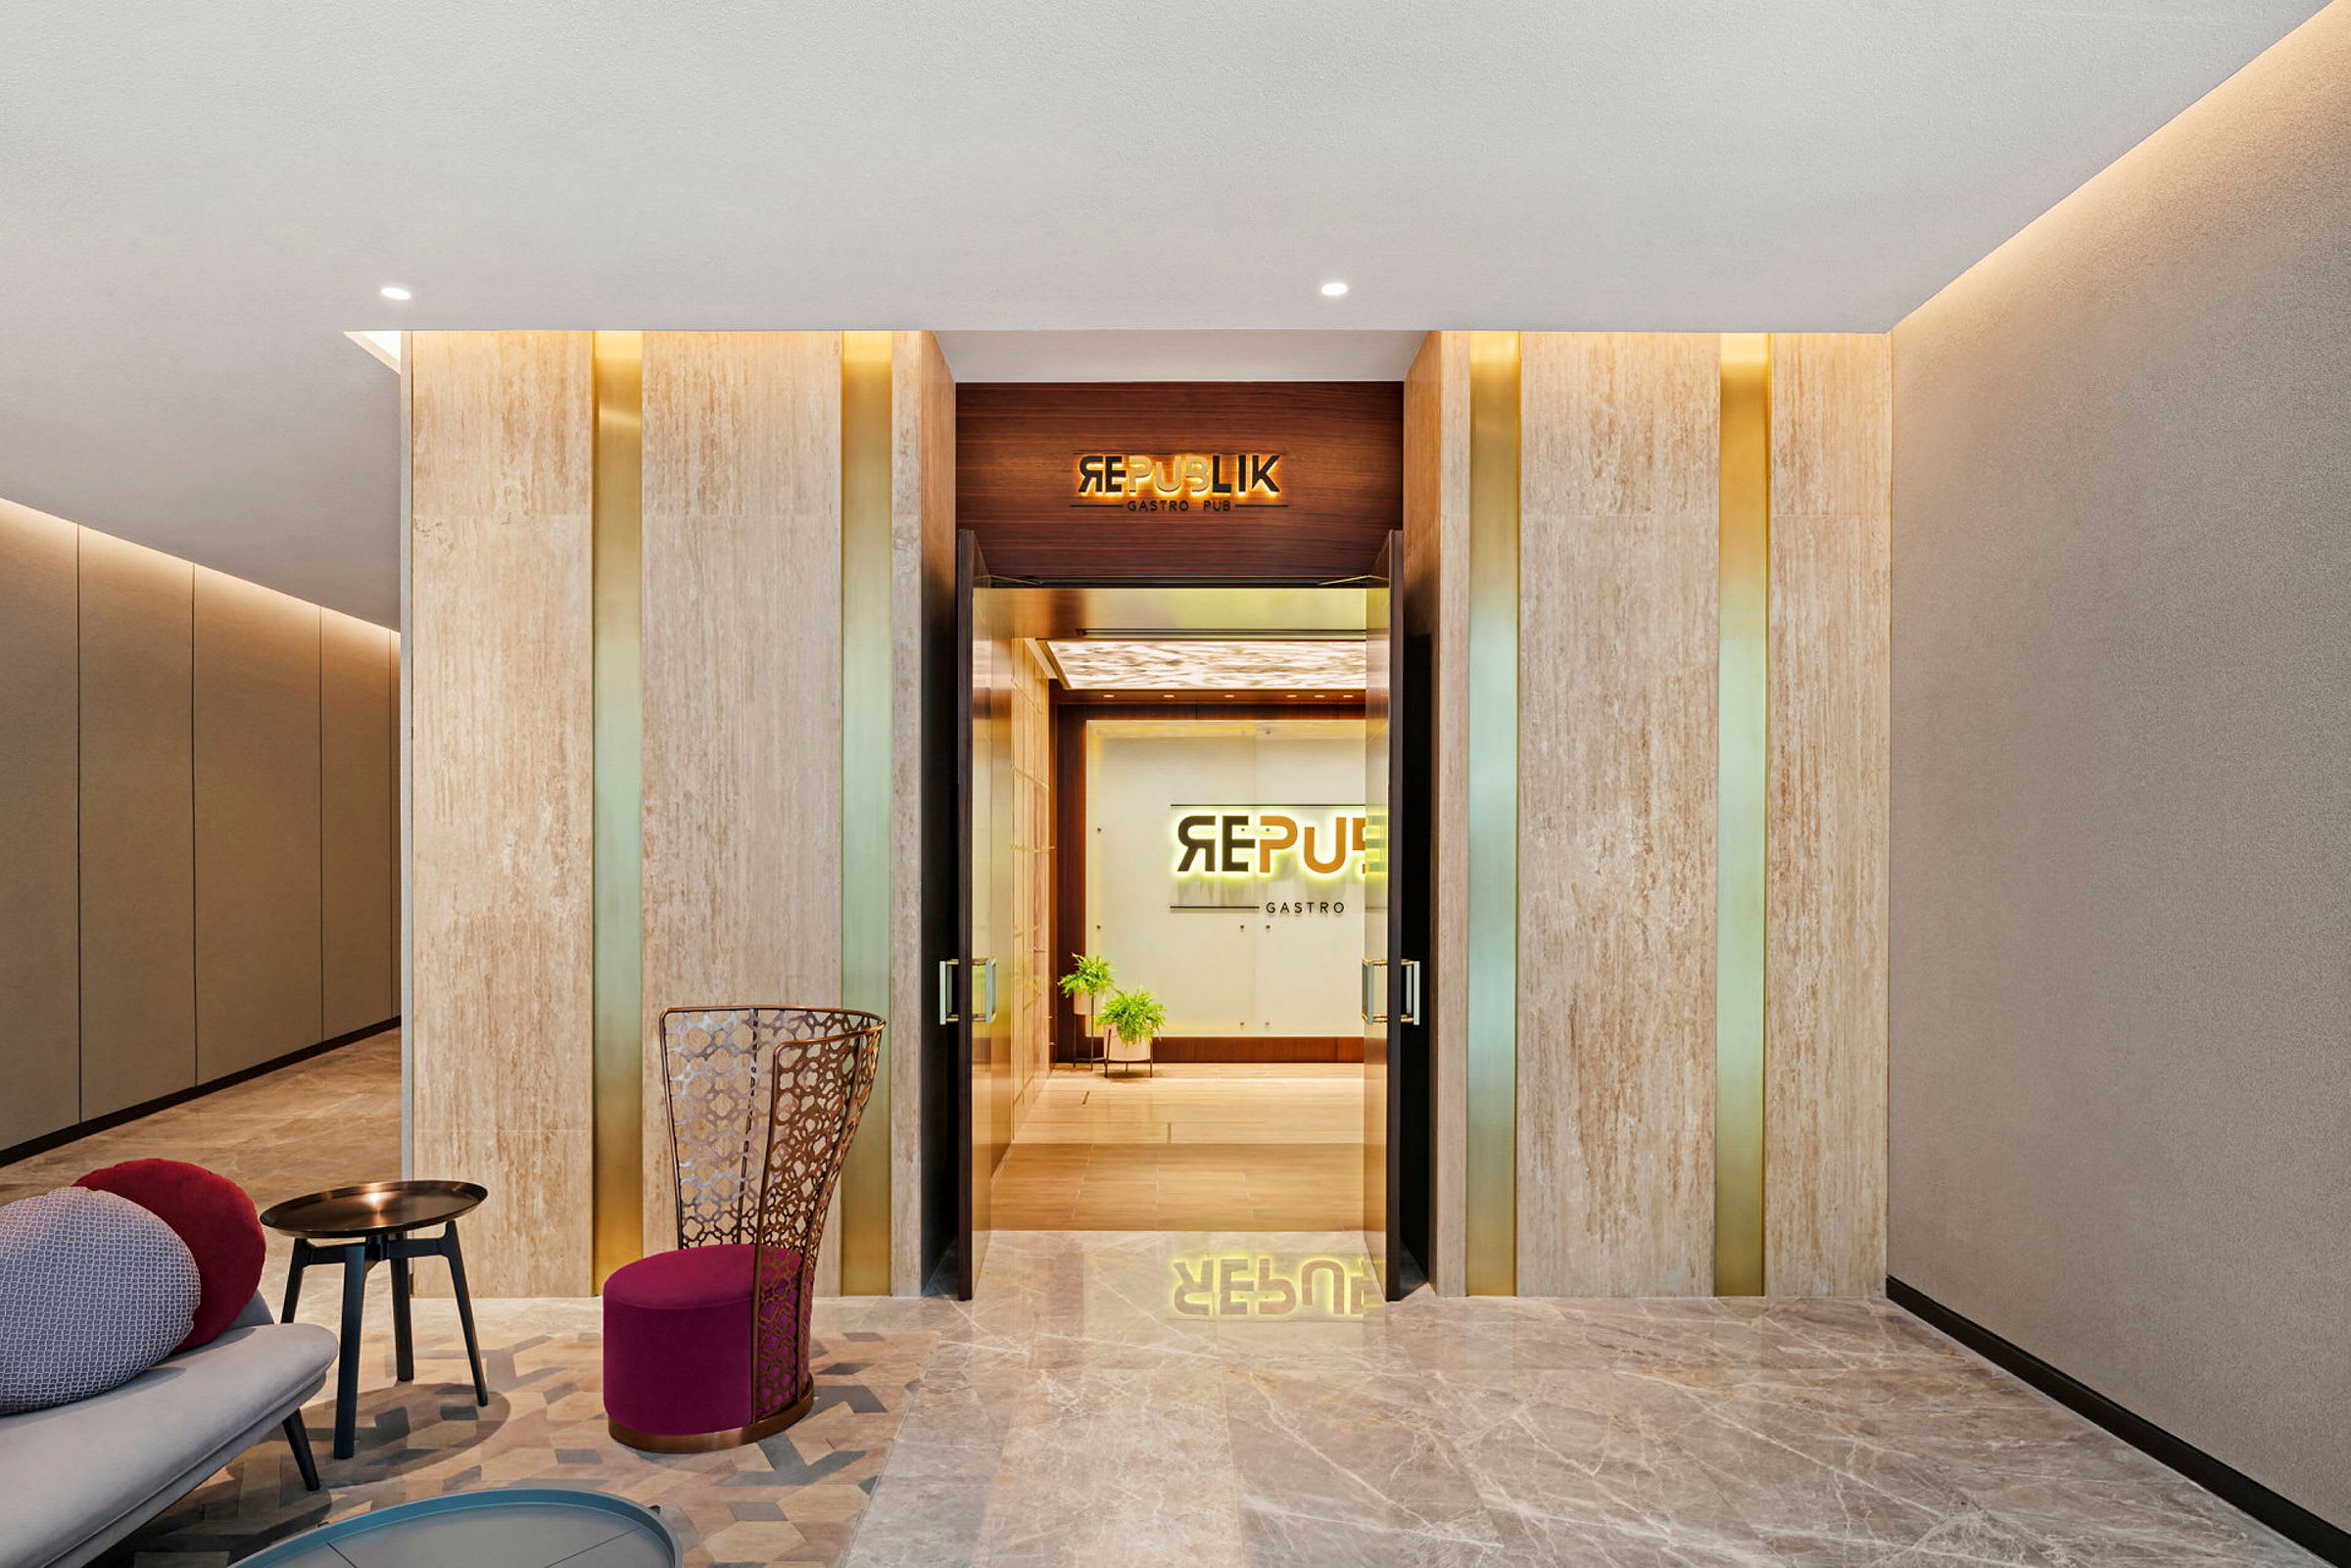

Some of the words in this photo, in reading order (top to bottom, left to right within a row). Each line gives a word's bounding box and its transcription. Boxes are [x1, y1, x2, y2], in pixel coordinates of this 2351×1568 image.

[1128, 499, 1190, 512] GASTRO
[1204, 499, 1231, 512] PUB
[1266, 901, 1345, 914] GASTRO
